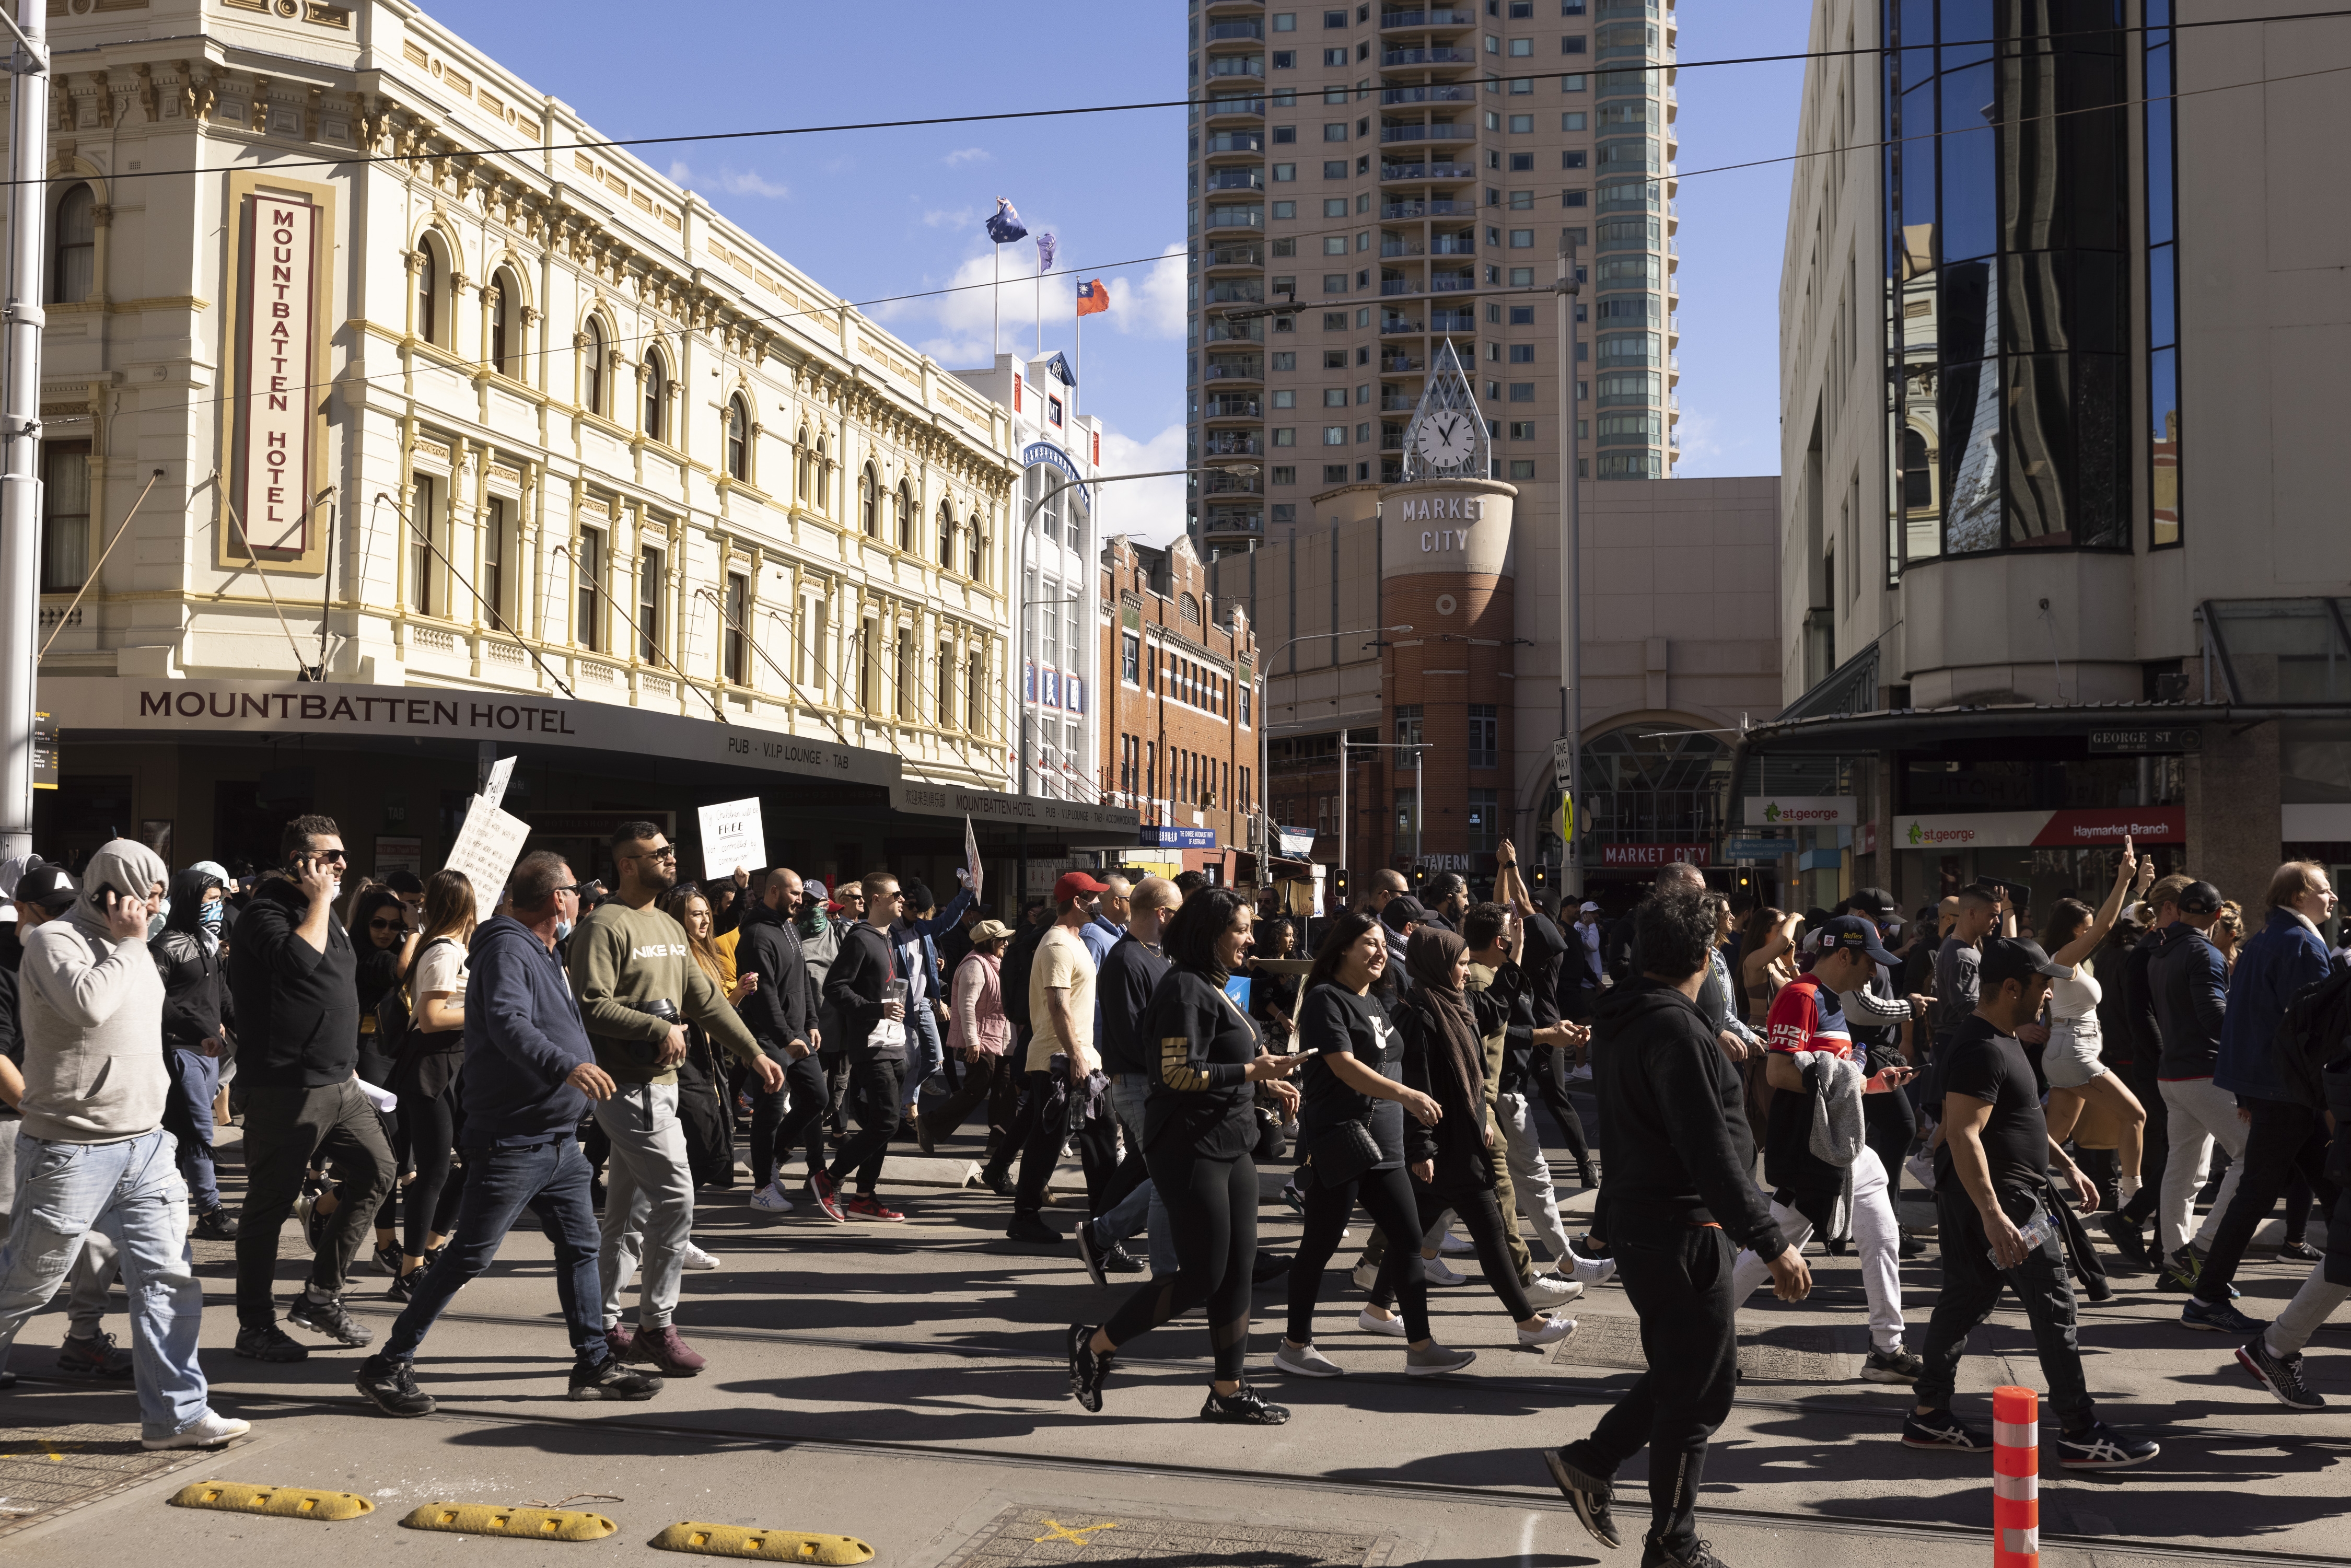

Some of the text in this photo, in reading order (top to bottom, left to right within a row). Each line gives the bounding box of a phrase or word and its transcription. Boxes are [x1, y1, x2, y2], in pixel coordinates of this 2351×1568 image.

[267, 208, 294, 522] MOUNTBATTEN HOTEL
[1052, 361, 1062, 379] 1921
[1049, 401, 1058, 422] MT
[1403, 498, 1486, 521] MARKET
[1421, 529, 1467, 553] CITY
[139, 691, 575, 735] MOUNTBATTEN HOTEL
[2093, 732, 2171, 743] GEORGE ST
[728, 737, 848, 769] PUB V.I.P LOUNGE TAB
[1555, 742, 1567, 756] ONE
[1556, 758, 1568, 771] WAY
[849, 790, 882, 798] 4894
[905, 788, 946, 808] 欢迎来到俱乐部
[716, 809, 740, 820] Children
[742, 807, 752, 817] will
[753, 805, 759, 814] be
[956, 794, 1036, 817] MOUNTBATTEN HOTEL
[388, 807, 404, 820] TAB
[1046, 807, 1056, 818] PUB
[1072, 810, 1089, 821] LOUNGE
[1094, 812, 1102, 822] TAB
[1105, 814, 1138, 826] ACCOMMODATION
[1783, 809, 1838, 821] st.george
[719, 821, 743, 835] FREE
[1924, 829, 1974, 842] st.george
[2074, 823, 2168, 838] Haymarket Branch
[706, 839, 756, 854] Not controlled by
[1605, 847, 1665, 862] MARKET
[1423, 855, 1469, 870] TAVERN
[633, 944, 668, 960] NIKE
[1771, 1037, 1799, 1048] UTE
[1672, 1477, 1683, 1508] COLLECTION
